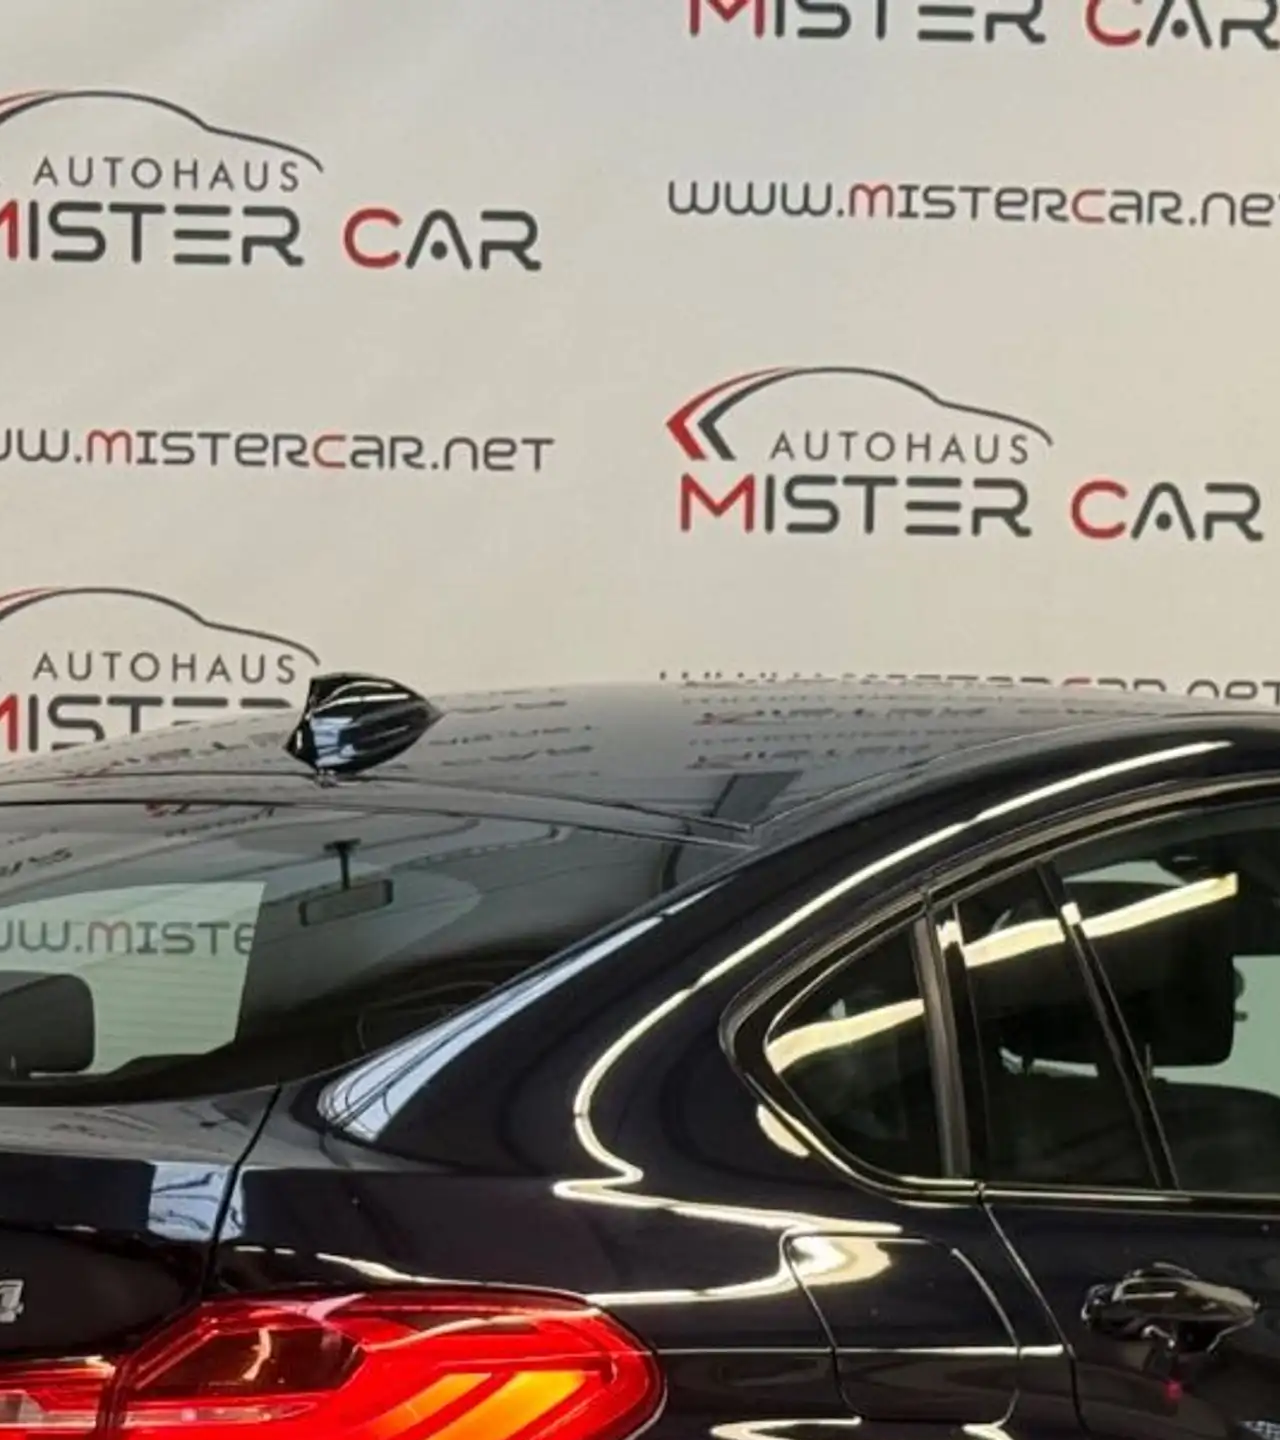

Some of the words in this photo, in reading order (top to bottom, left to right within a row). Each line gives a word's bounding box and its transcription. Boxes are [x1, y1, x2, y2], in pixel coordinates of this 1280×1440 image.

[31, 156, 300, 193] AUTOHAUS
[342, 206, 543, 273] CAR
[768, 429, 1029, 466] AUTOHAUS
[679, 471, 1034, 539] MISTER
[1069, 478, 1265, 544] CAR
[31, 650, 296, 686] AUTOHAUS
